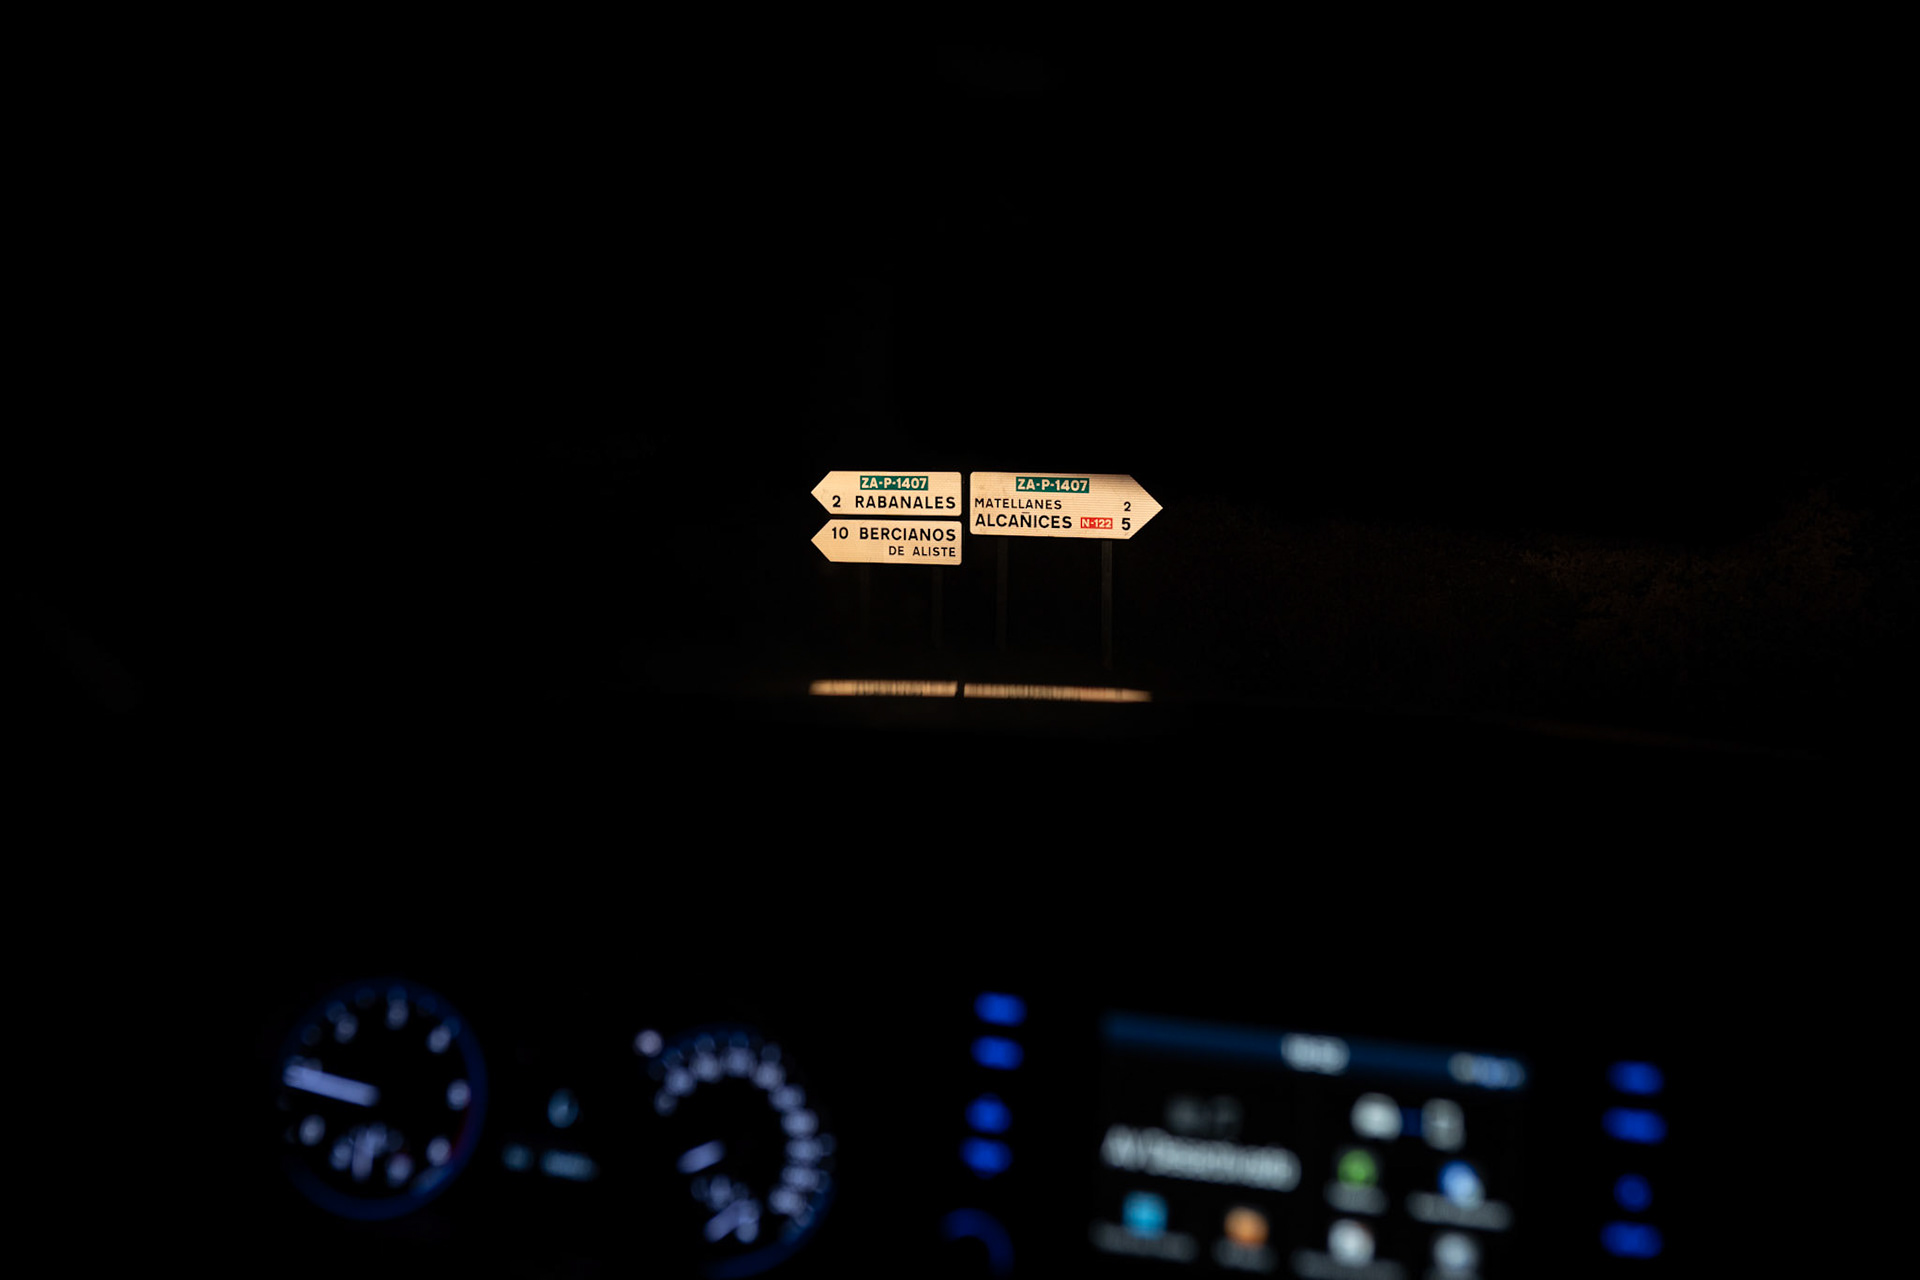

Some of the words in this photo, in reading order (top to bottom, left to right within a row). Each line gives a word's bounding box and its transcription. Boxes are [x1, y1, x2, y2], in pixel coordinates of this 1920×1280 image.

[861, 477, 927, 489] ZA-P-1407
[1017, 478, 1088, 492] ZA-P-1407
[832, 495, 841, 508] 2
[855, 496, 956, 509] RABANALES
[974, 498, 1062, 510] MATELLANES
[1123, 501, 1131, 512] 2
[975, 512, 1073, 529] ALCAÑICES
[1081, 518, 1112, 528] N-122
[1121, 518, 1131, 531] 5
[832, 527, 848, 539] 10
[859, 527, 956, 541] BERCIANOS
[888, 546, 905, 556] DE
[912, 546, 956, 557] ALISTE
